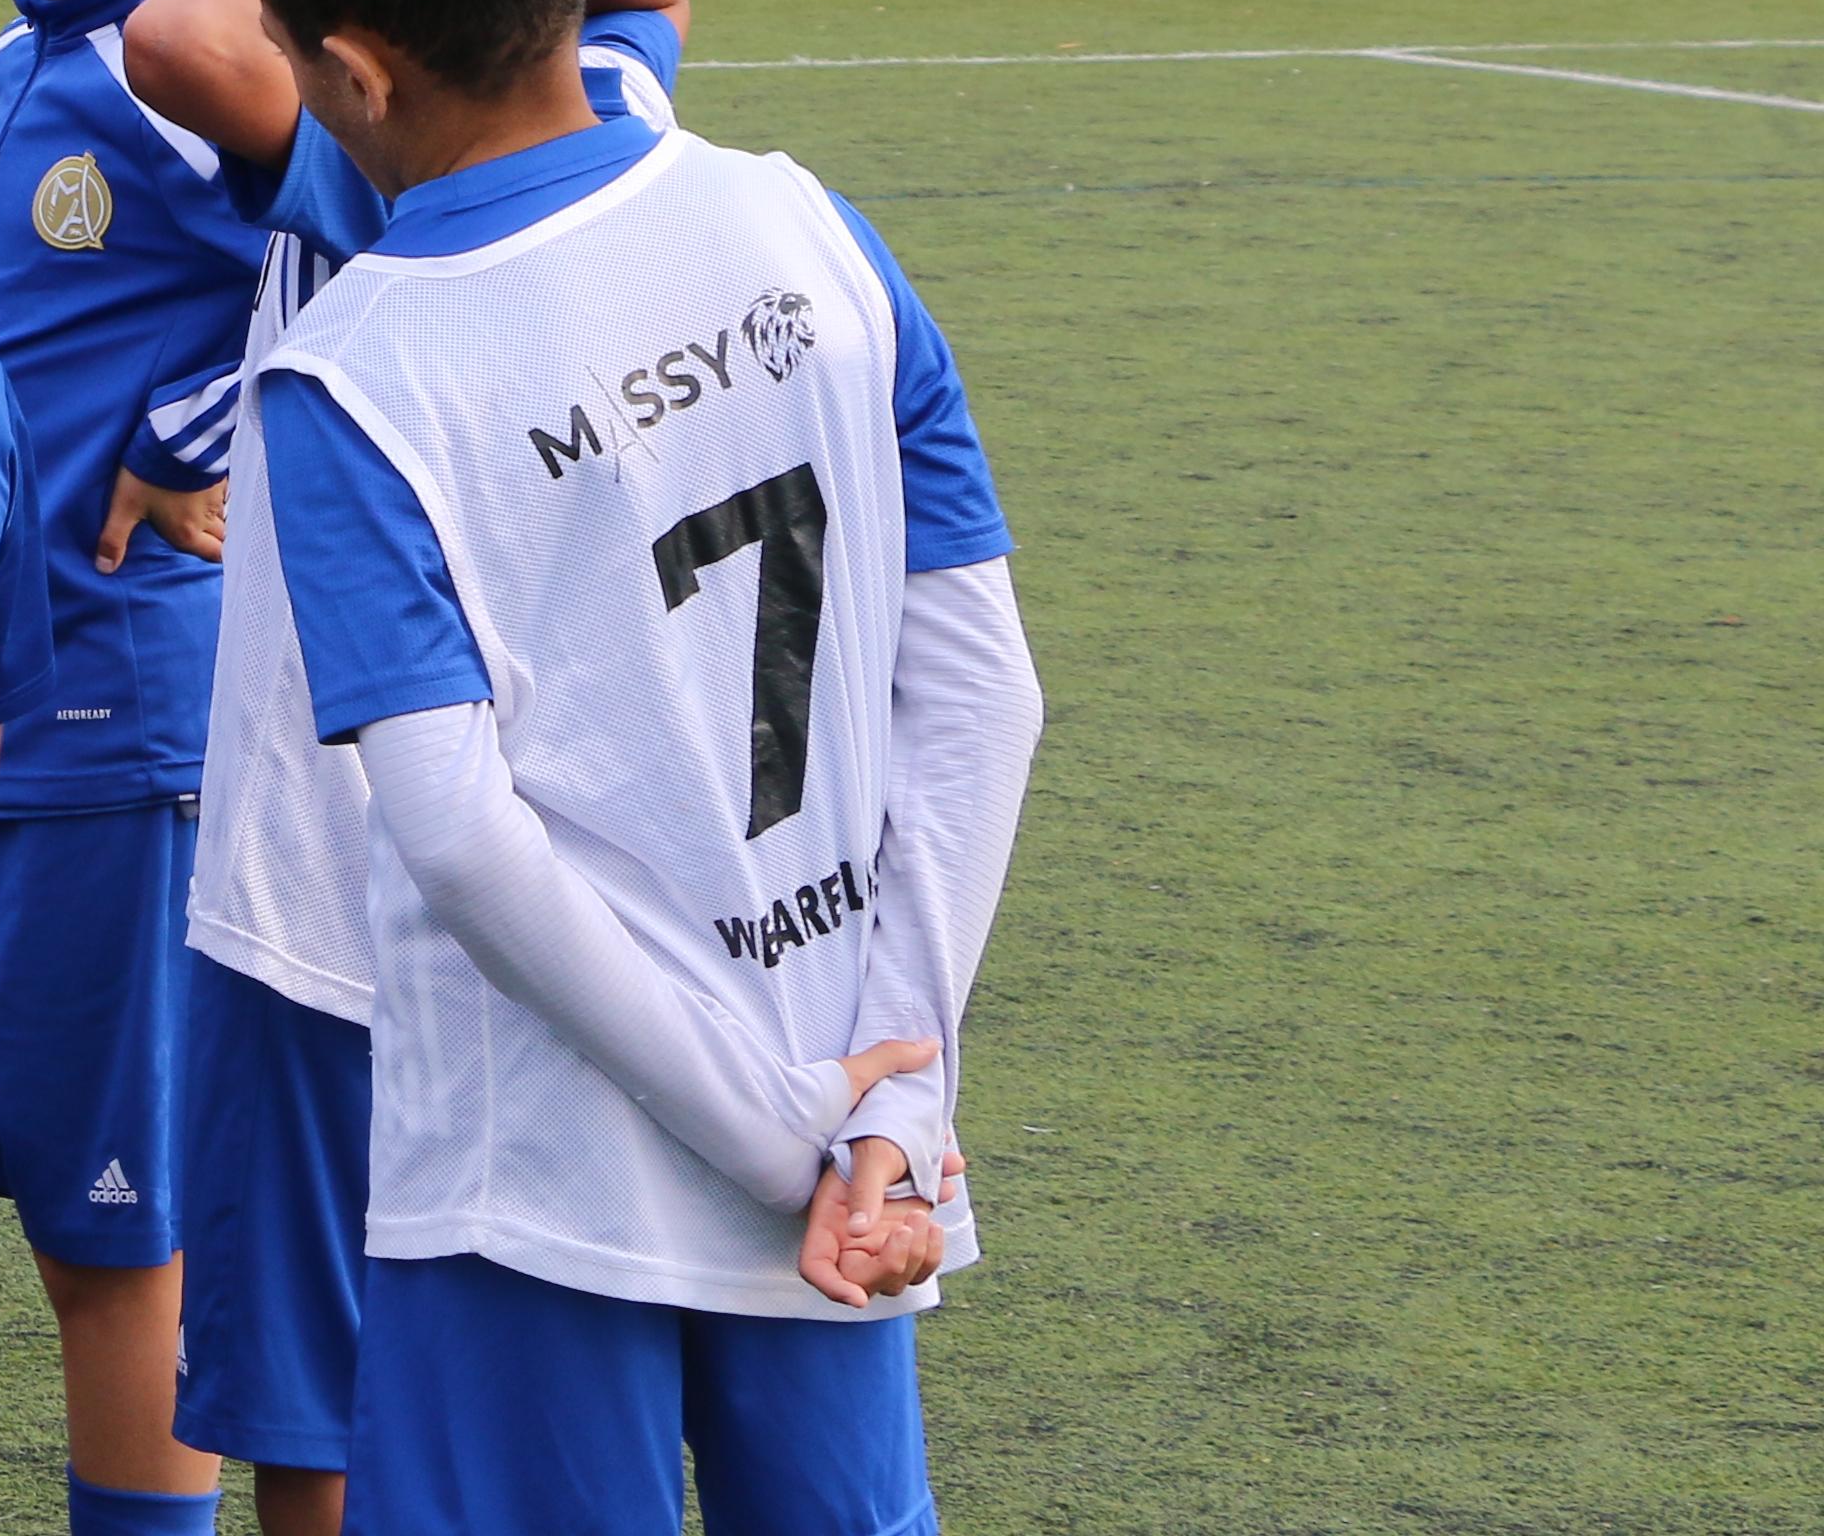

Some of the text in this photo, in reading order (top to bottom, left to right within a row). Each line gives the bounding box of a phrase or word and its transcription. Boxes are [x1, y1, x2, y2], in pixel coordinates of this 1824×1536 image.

[527, 328, 732, 484] MASSY
[652, 461, 828, 841] 7
[88, 1186, 138, 1204] adidas
